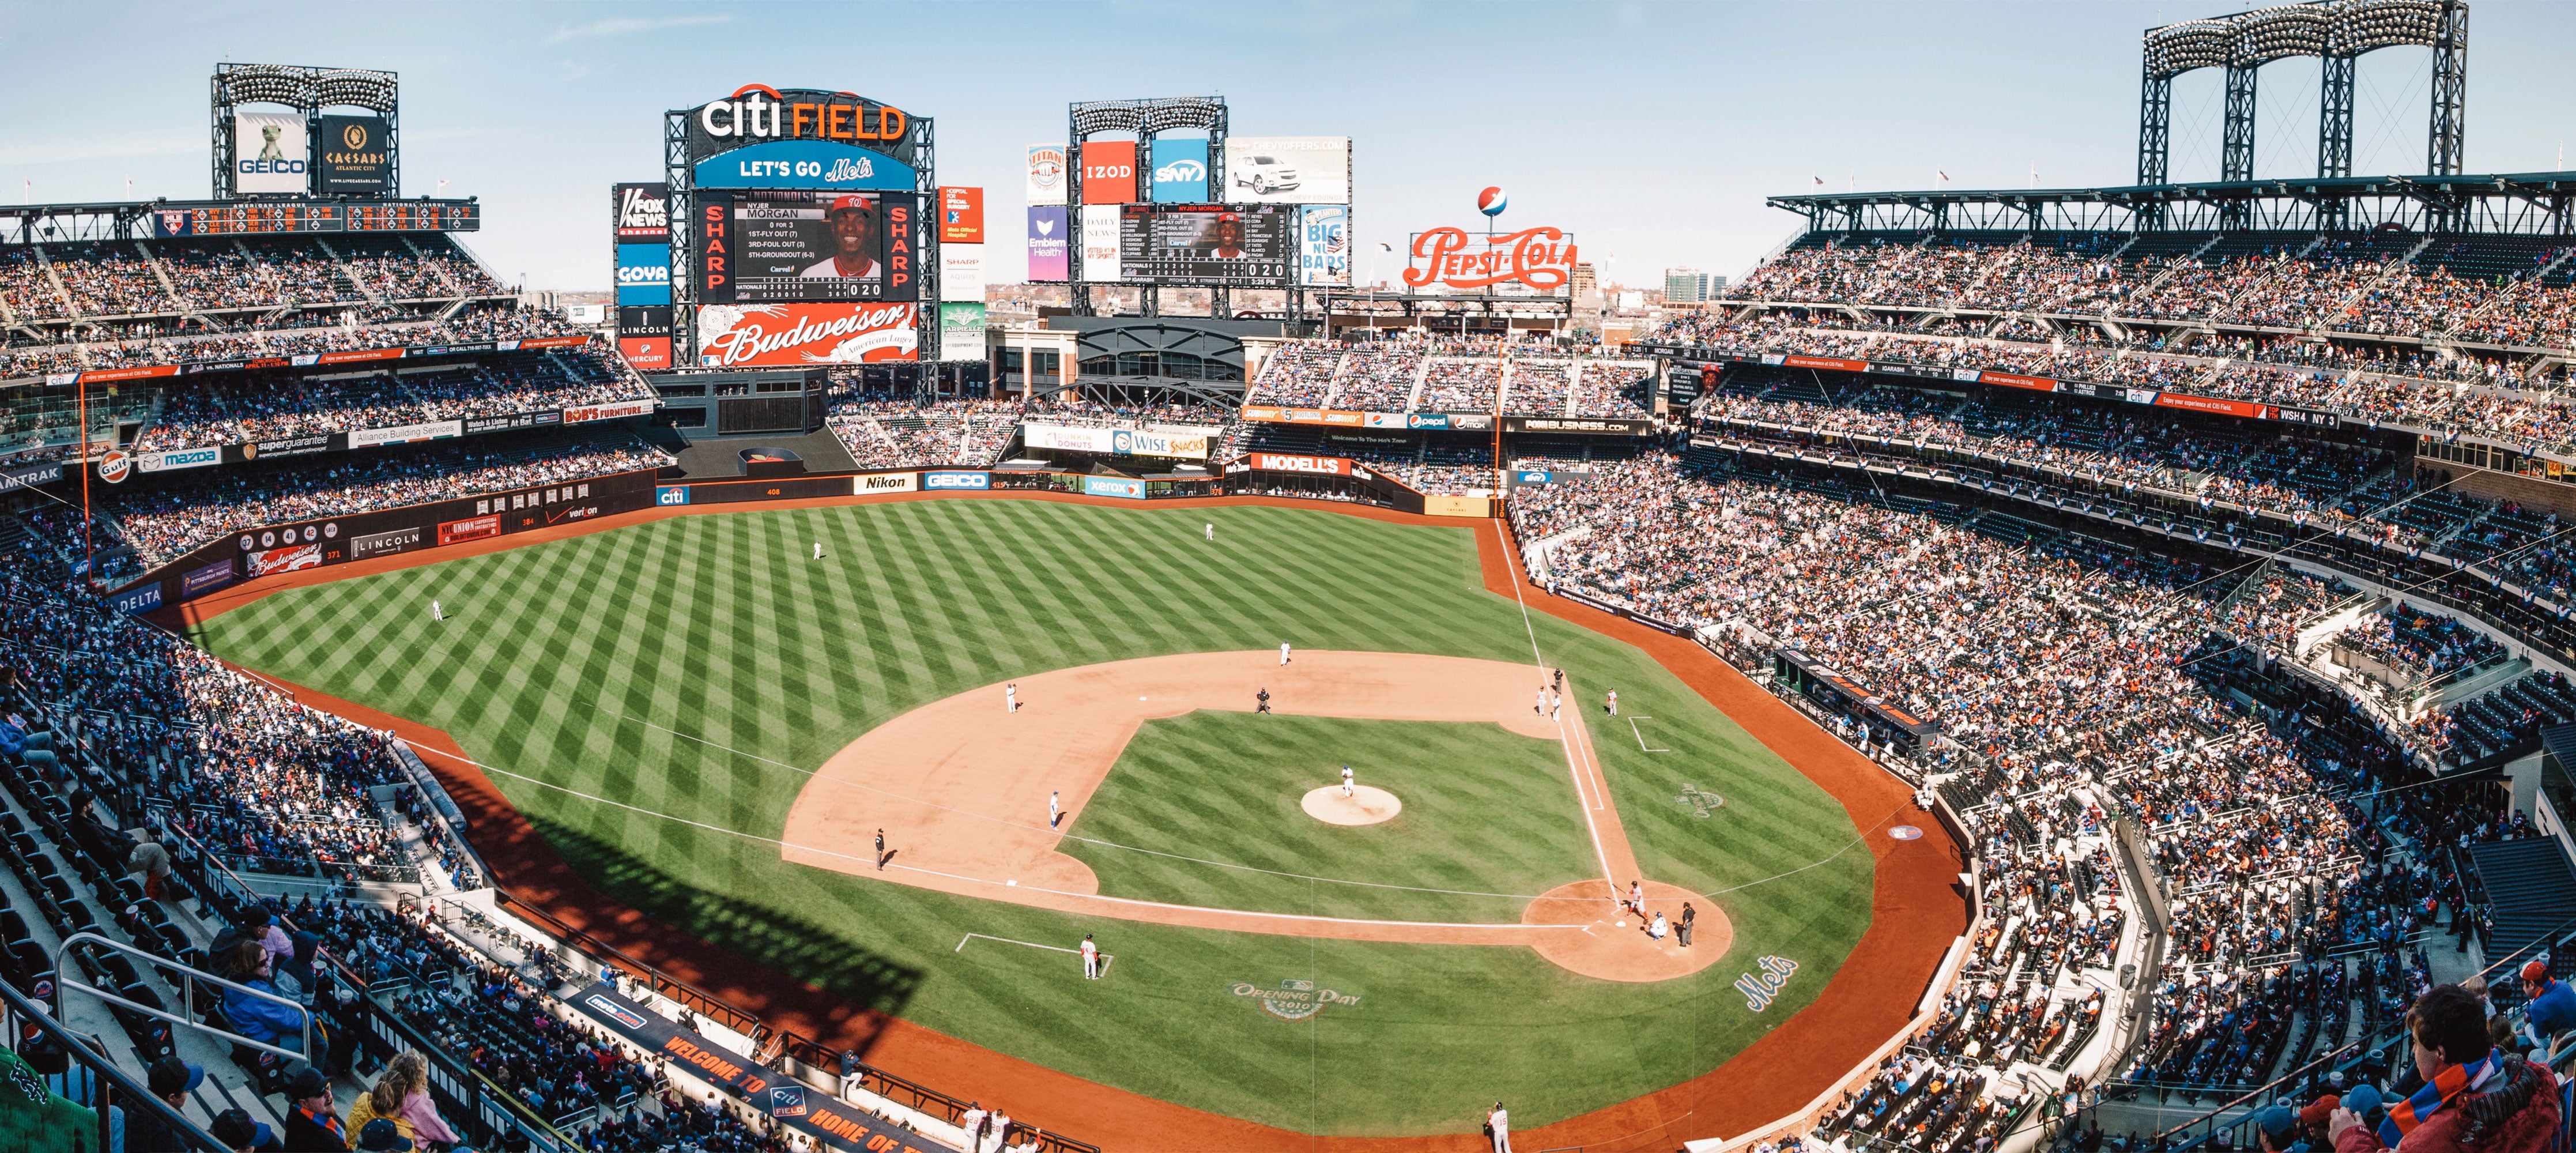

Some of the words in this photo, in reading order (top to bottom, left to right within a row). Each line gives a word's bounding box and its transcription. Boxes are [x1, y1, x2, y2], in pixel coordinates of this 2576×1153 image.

[702, 93, 780, 137] citi
[793, 103, 905, 140] FIELD
[1253, 141, 1344, 151] CHEVYOFFERS.COM
[326, 152, 384, 164] CAESARS
[1032, 150, 1061, 164] TITAN
[239, 160, 305, 174] GEICO
[741, 160, 790, 177] LET'S
[795, 161, 821, 177] GO
[825, 157, 874, 182] Mets
[1087, 165, 1131, 178] IZOD
[635, 199, 666, 213] FOX
[627, 213, 667, 227] NEWS
[748, 210, 798, 218] MORGAN
[1308, 224, 1341, 242] BIG
[706, 206, 726, 289] SHARP
[891, 208, 908, 287] SHARP
[1029, 238, 1066, 247] Emblem
[1303, 255, 1345, 269] BARS
[618, 266, 667, 282] GOYA
[712, 306, 905, 364] Budweiser
[2059, 383, 2067, 391] NL
[2131, 392, 2143, 402] citi
[2163, 397, 2173, 405] Enjoy
[2174, 398, 2183, 406] your
[2184, 400, 2205, 409] experience
[565, 408, 598, 422] BOB'S
[600, 406, 641, 419] FURNITURE
[1244, 409, 1279, 419] SUBWAY
[1281, 409, 1292, 421] $5
[1295, 411, 1321, 420] FOOTLONG
[1325, 414, 1361, 423] SUBWAY
[2281, 410, 2299, 420] WSH
[2300, 412, 2306, 421] 4
[2313, 414, 2325, 424] NY
[2329, 415, 2334, 425] 3
[520, 418, 532, 426] Bat
[1421, 417, 1445, 426] pepsi
[1548, 420, 1628, 431] BUSINESS.COM
[357, 432, 388, 442] Alliance
[390, 428, 420, 440] Building
[423, 424, 454, 435] Services
[258, 436, 327, 451] superguarantee
[1058, 440, 1092, 449] DONUTS
[1134, 435, 1167, 451] WISE
[1171, 438, 1204, 454] SNACKS
[165, 450, 216, 466] mazda
[1262, 455, 1338, 474] MODELL'S
[101, 458, 127, 474] Gulf
[866, 477, 906, 490] Nikon
[927, 474, 986, 487] GEICO
[1091, 481, 1126, 492] xerox
[569, 506, 597, 518] verizon
[360, 534, 419, 551] LINCOLN
[256, 544, 316, 576] Budweiser
[327, 551, 340, 559] 371
[191, 572, 214, 584] PITTSBURGH
[120, 589, 161, 613] DELTA
[1734, 955, 1799, 1012] Mets
[1232, 983, 1310, 1001] OPENING
[1315, 989, 1360, 1006] DAY
[590, 996, 644, 1028] mets.com
[1278, 1001, 1311, 1010] 2010
[663, 1035, 744, 1083] WELCOME
[738, 1073, 768, 1094] TO
[775, 1105, 804, 1115] FIELD
[969, 1116, 978, 1124] 28
[1499, 1118, 1507, 1126] 15
[808, 1109, 870, 1144] HOME
[866, 1134, 900, 1153] OF
[992, 1124, 1000, 1132] 20
